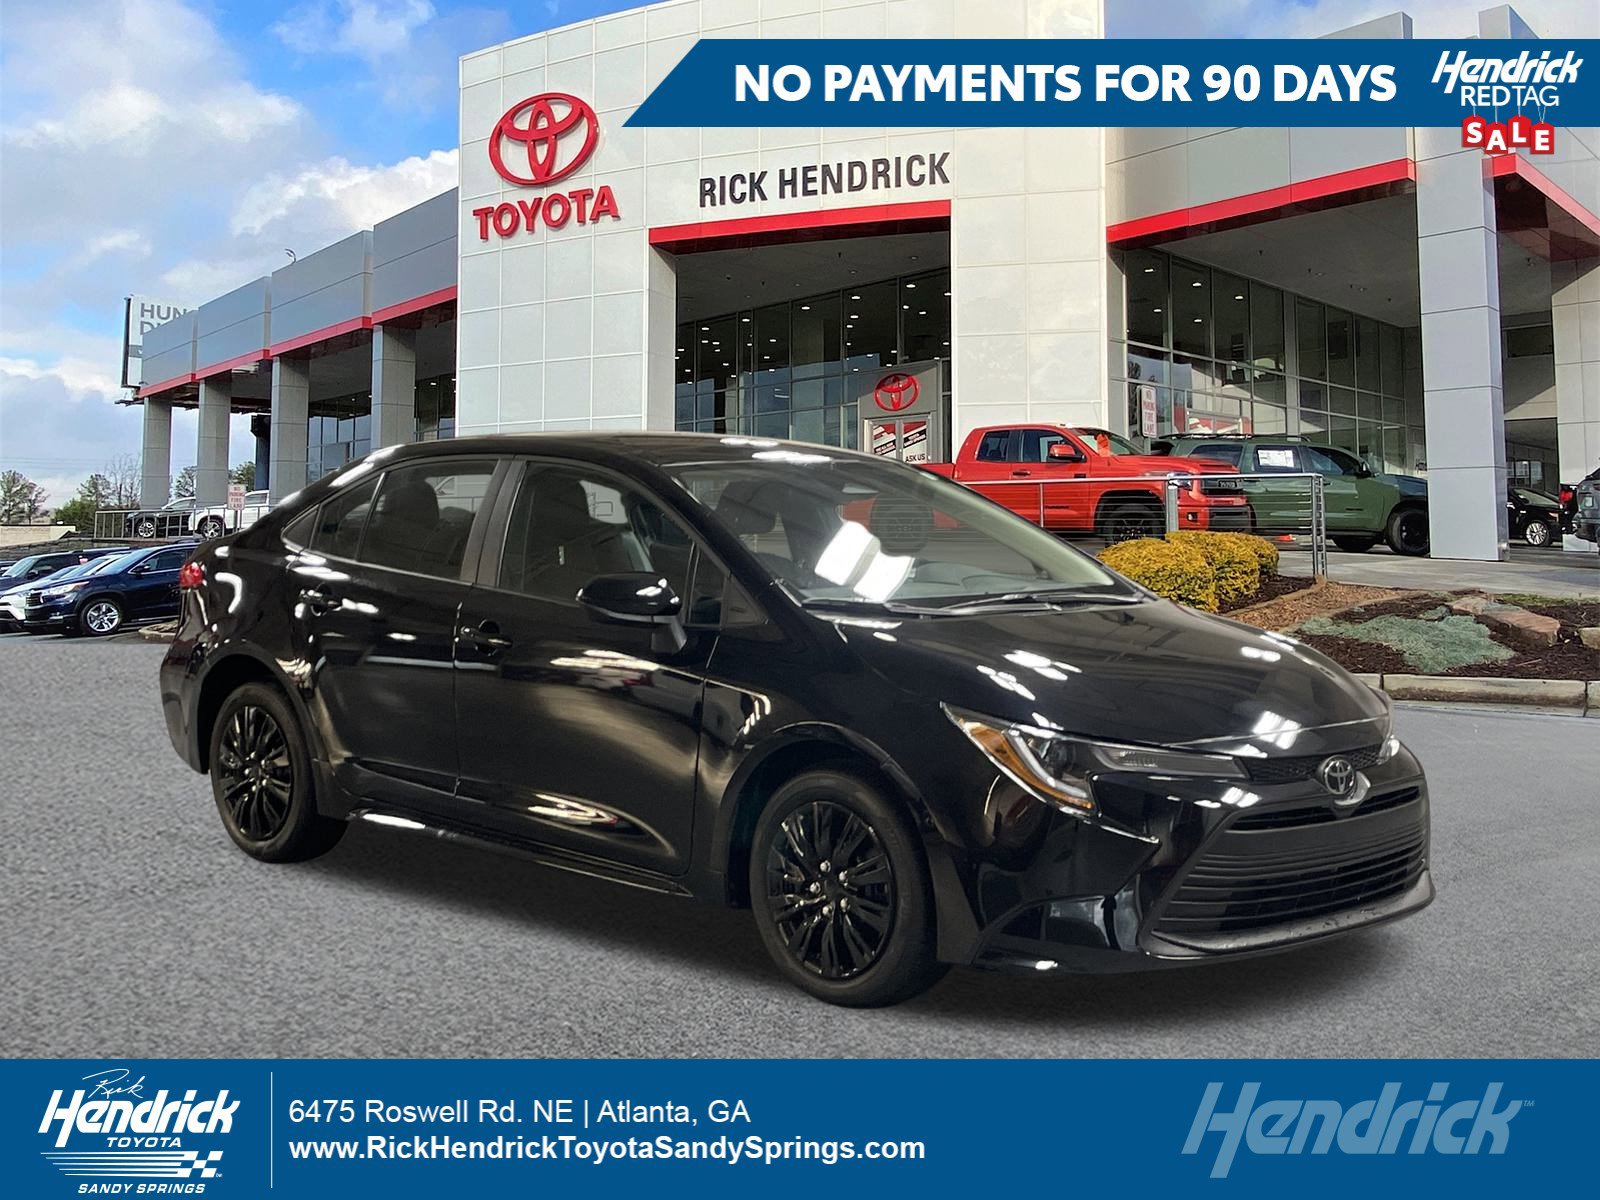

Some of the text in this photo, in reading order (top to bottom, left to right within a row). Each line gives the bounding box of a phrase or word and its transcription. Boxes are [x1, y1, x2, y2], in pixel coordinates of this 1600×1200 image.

[700, 152, 951, 208] RICK HENDRICK
[472, 185, 621, 241] TOYOTA
